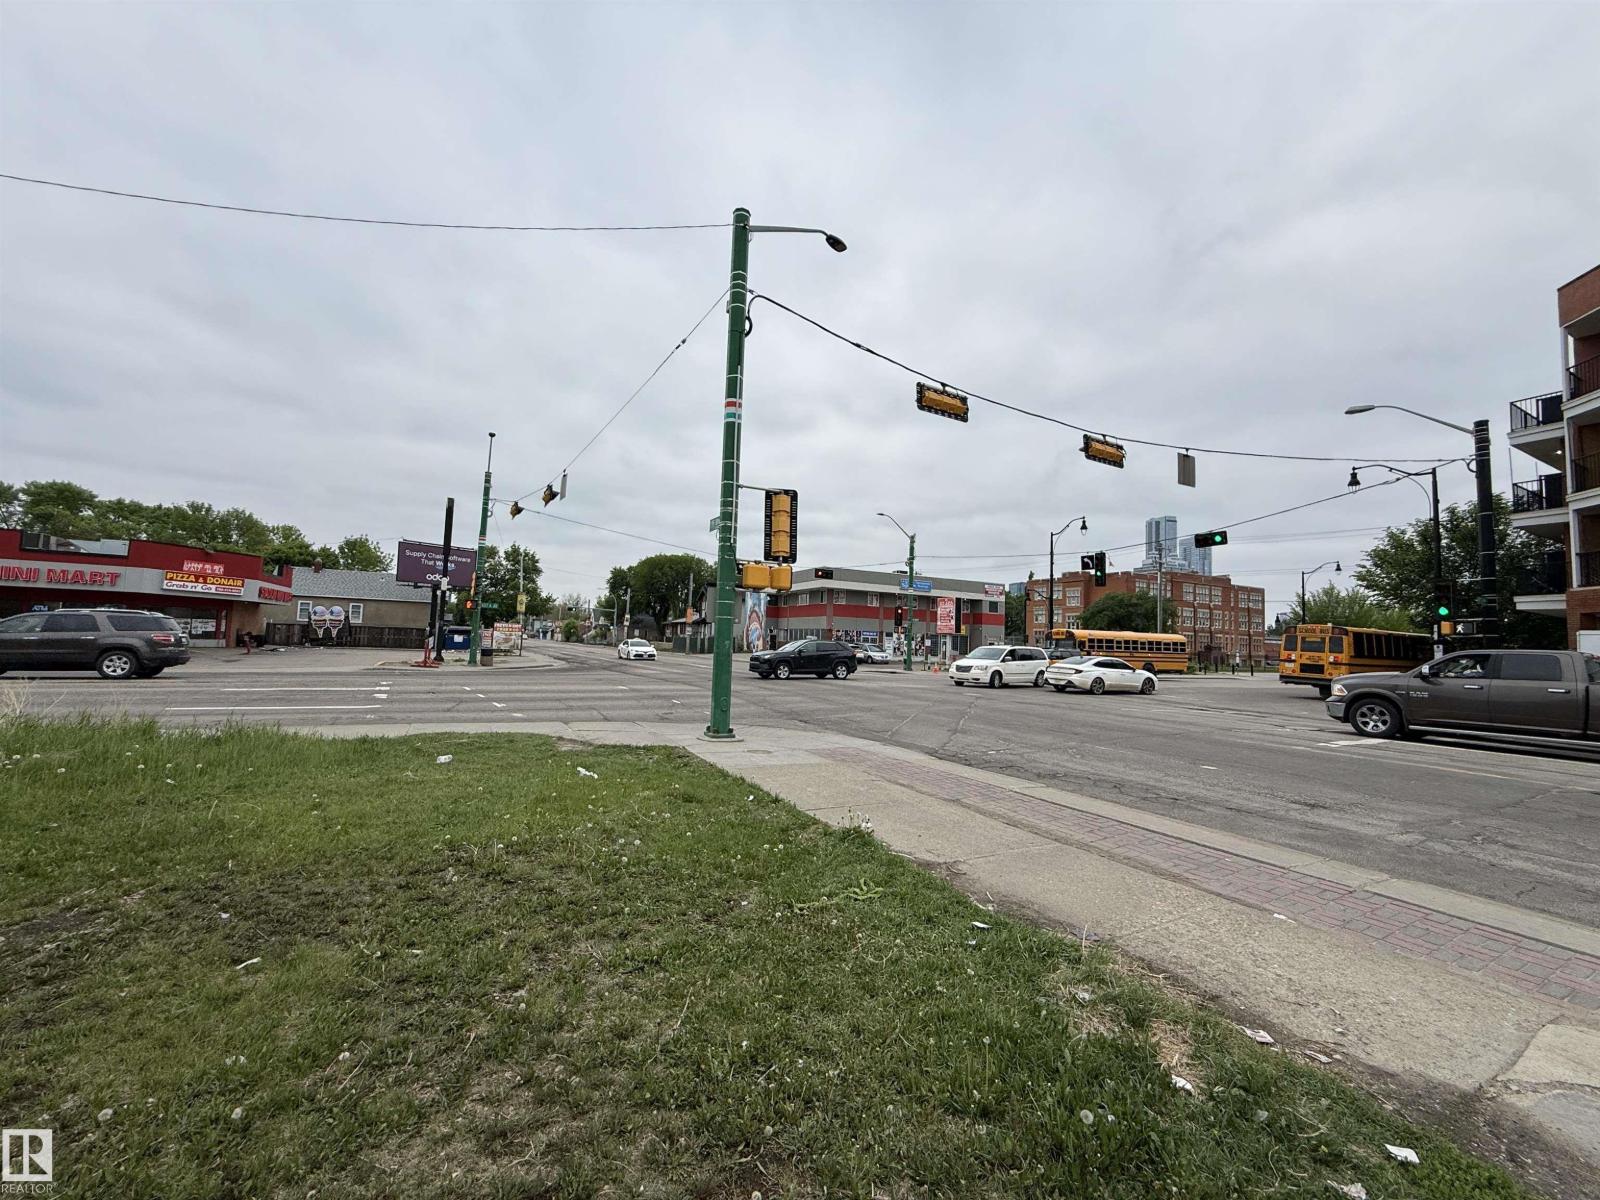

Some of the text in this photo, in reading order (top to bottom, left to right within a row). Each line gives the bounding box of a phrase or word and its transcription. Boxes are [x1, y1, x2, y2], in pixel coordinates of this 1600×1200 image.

[405, 550, 427, 558] Supply
[421, 558, 435, 566] That
[0, 566, 121, 586] INI MART
[166, 572, 196, 582] PIZZA
[207, 576, 243, 586] DONAIR
